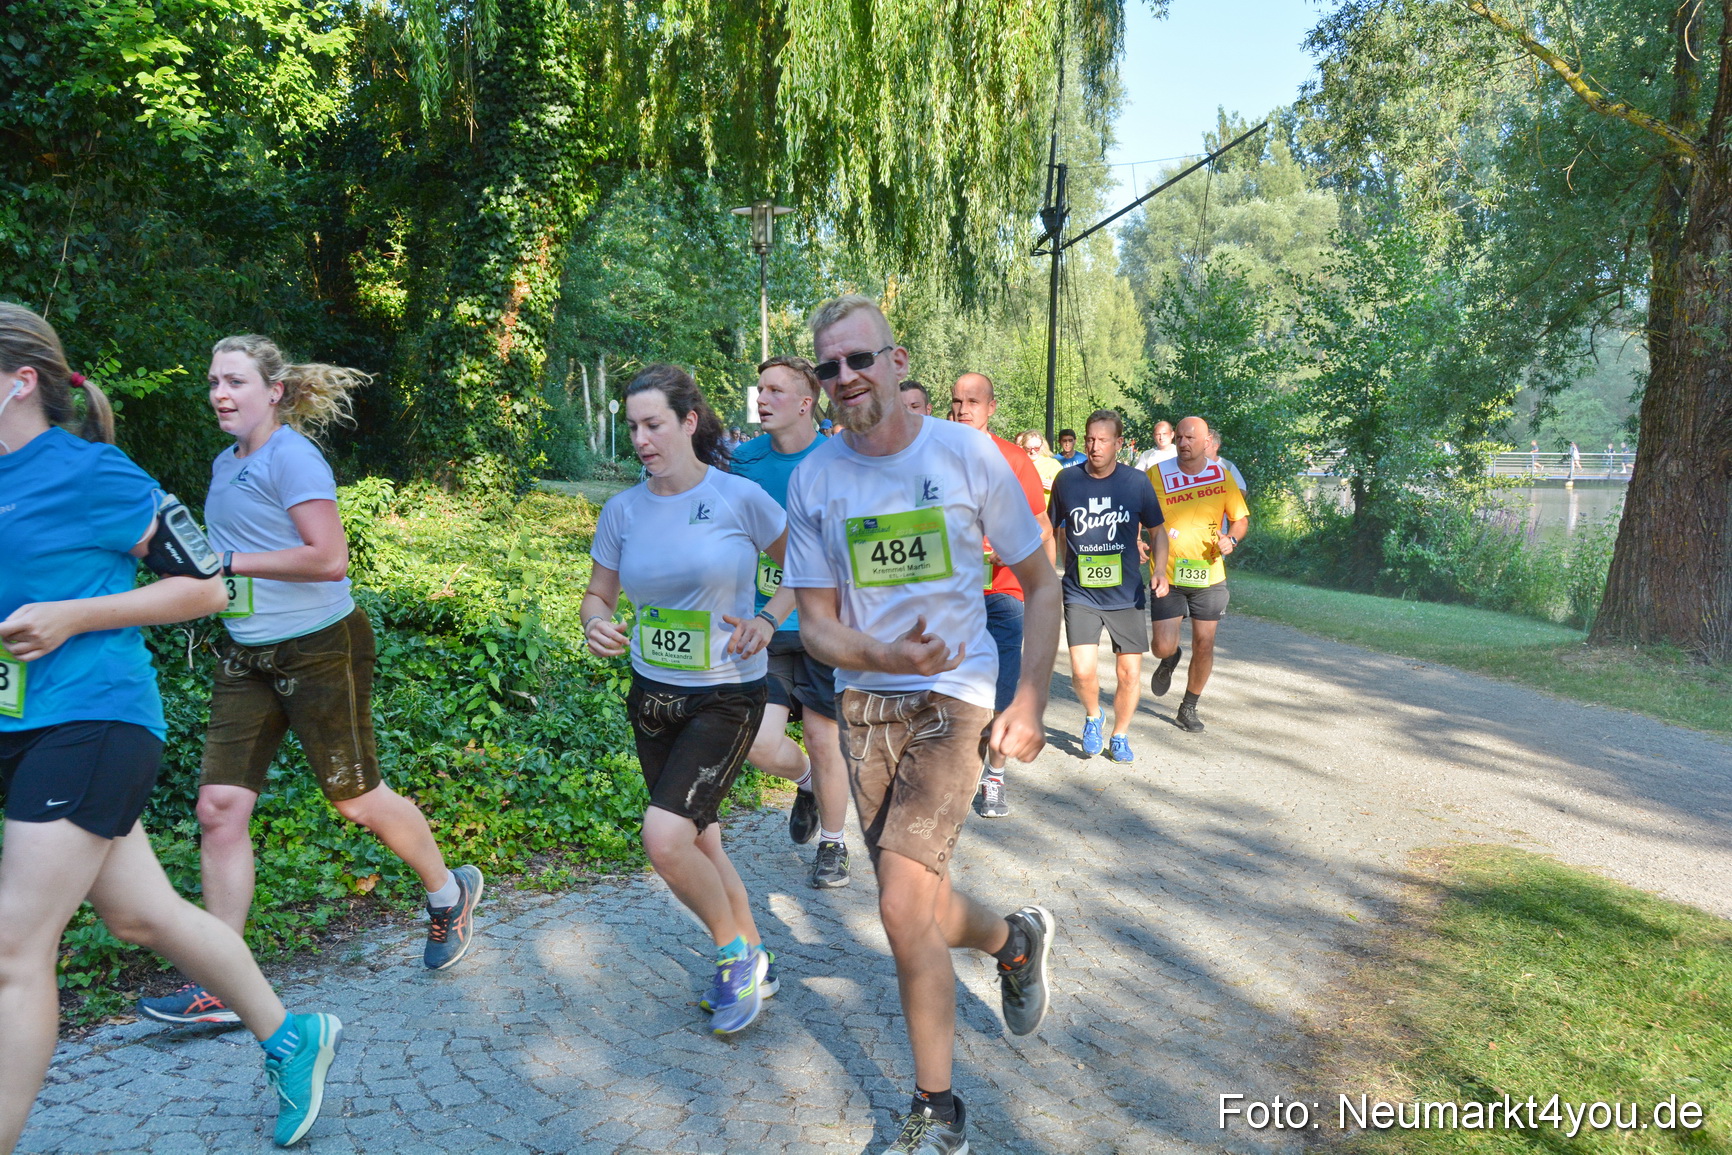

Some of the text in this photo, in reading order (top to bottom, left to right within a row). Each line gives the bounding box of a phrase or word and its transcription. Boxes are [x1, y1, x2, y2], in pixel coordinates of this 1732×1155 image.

[1165, 486, 1227, 505] MAX BÖGL
[1069, 505, 1130, 541] Burgis
[871, 536, 927, 566] 484
[907, 562, 931, 572] Martin
[1087, 567, 1112, 579] 269
[1178, 568, 1207, 580] 1338
[651, 629, 691, 653] 482
[665, 651, 693, 660] Alexandra
